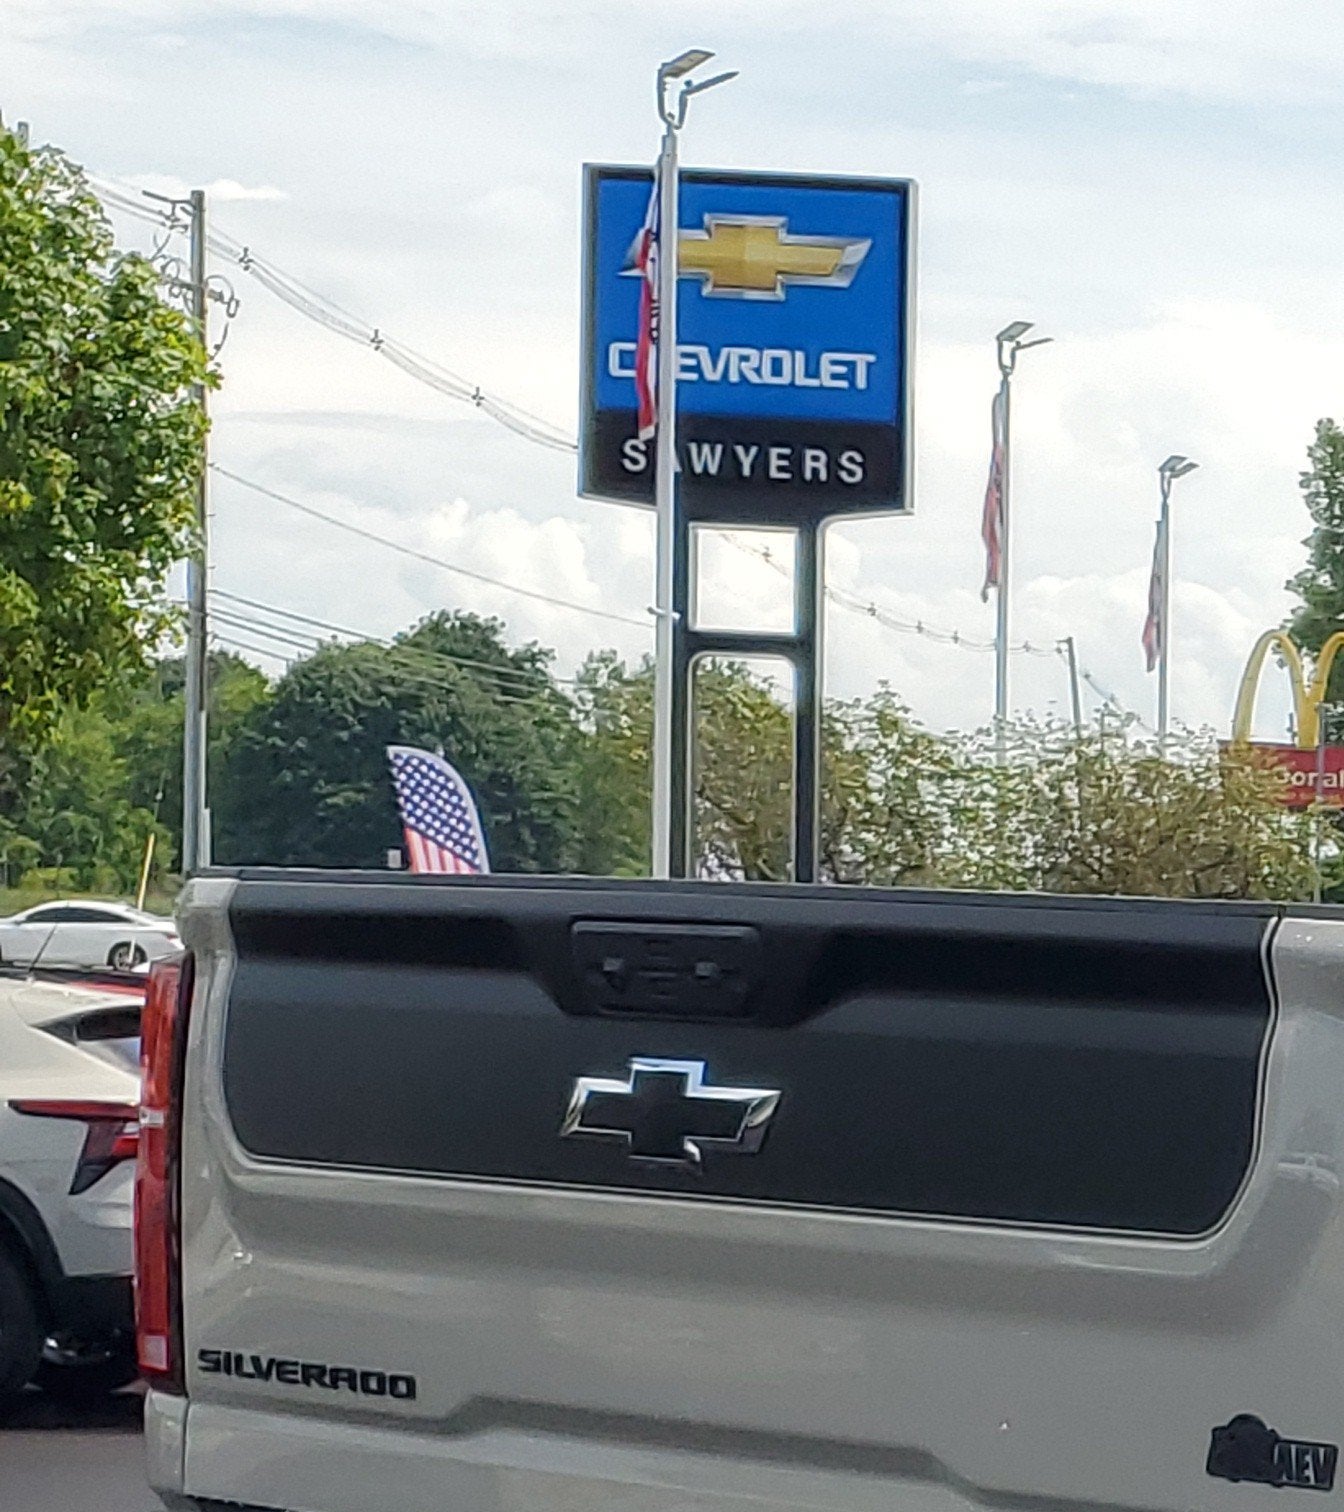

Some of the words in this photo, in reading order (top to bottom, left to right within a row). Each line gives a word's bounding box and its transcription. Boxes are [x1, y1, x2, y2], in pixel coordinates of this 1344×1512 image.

[608, 341, 877, 390] CEVROLET
[621, 438, 866, 484] SWYERS
[197, 1348, 417, 1401] SILVERADO
